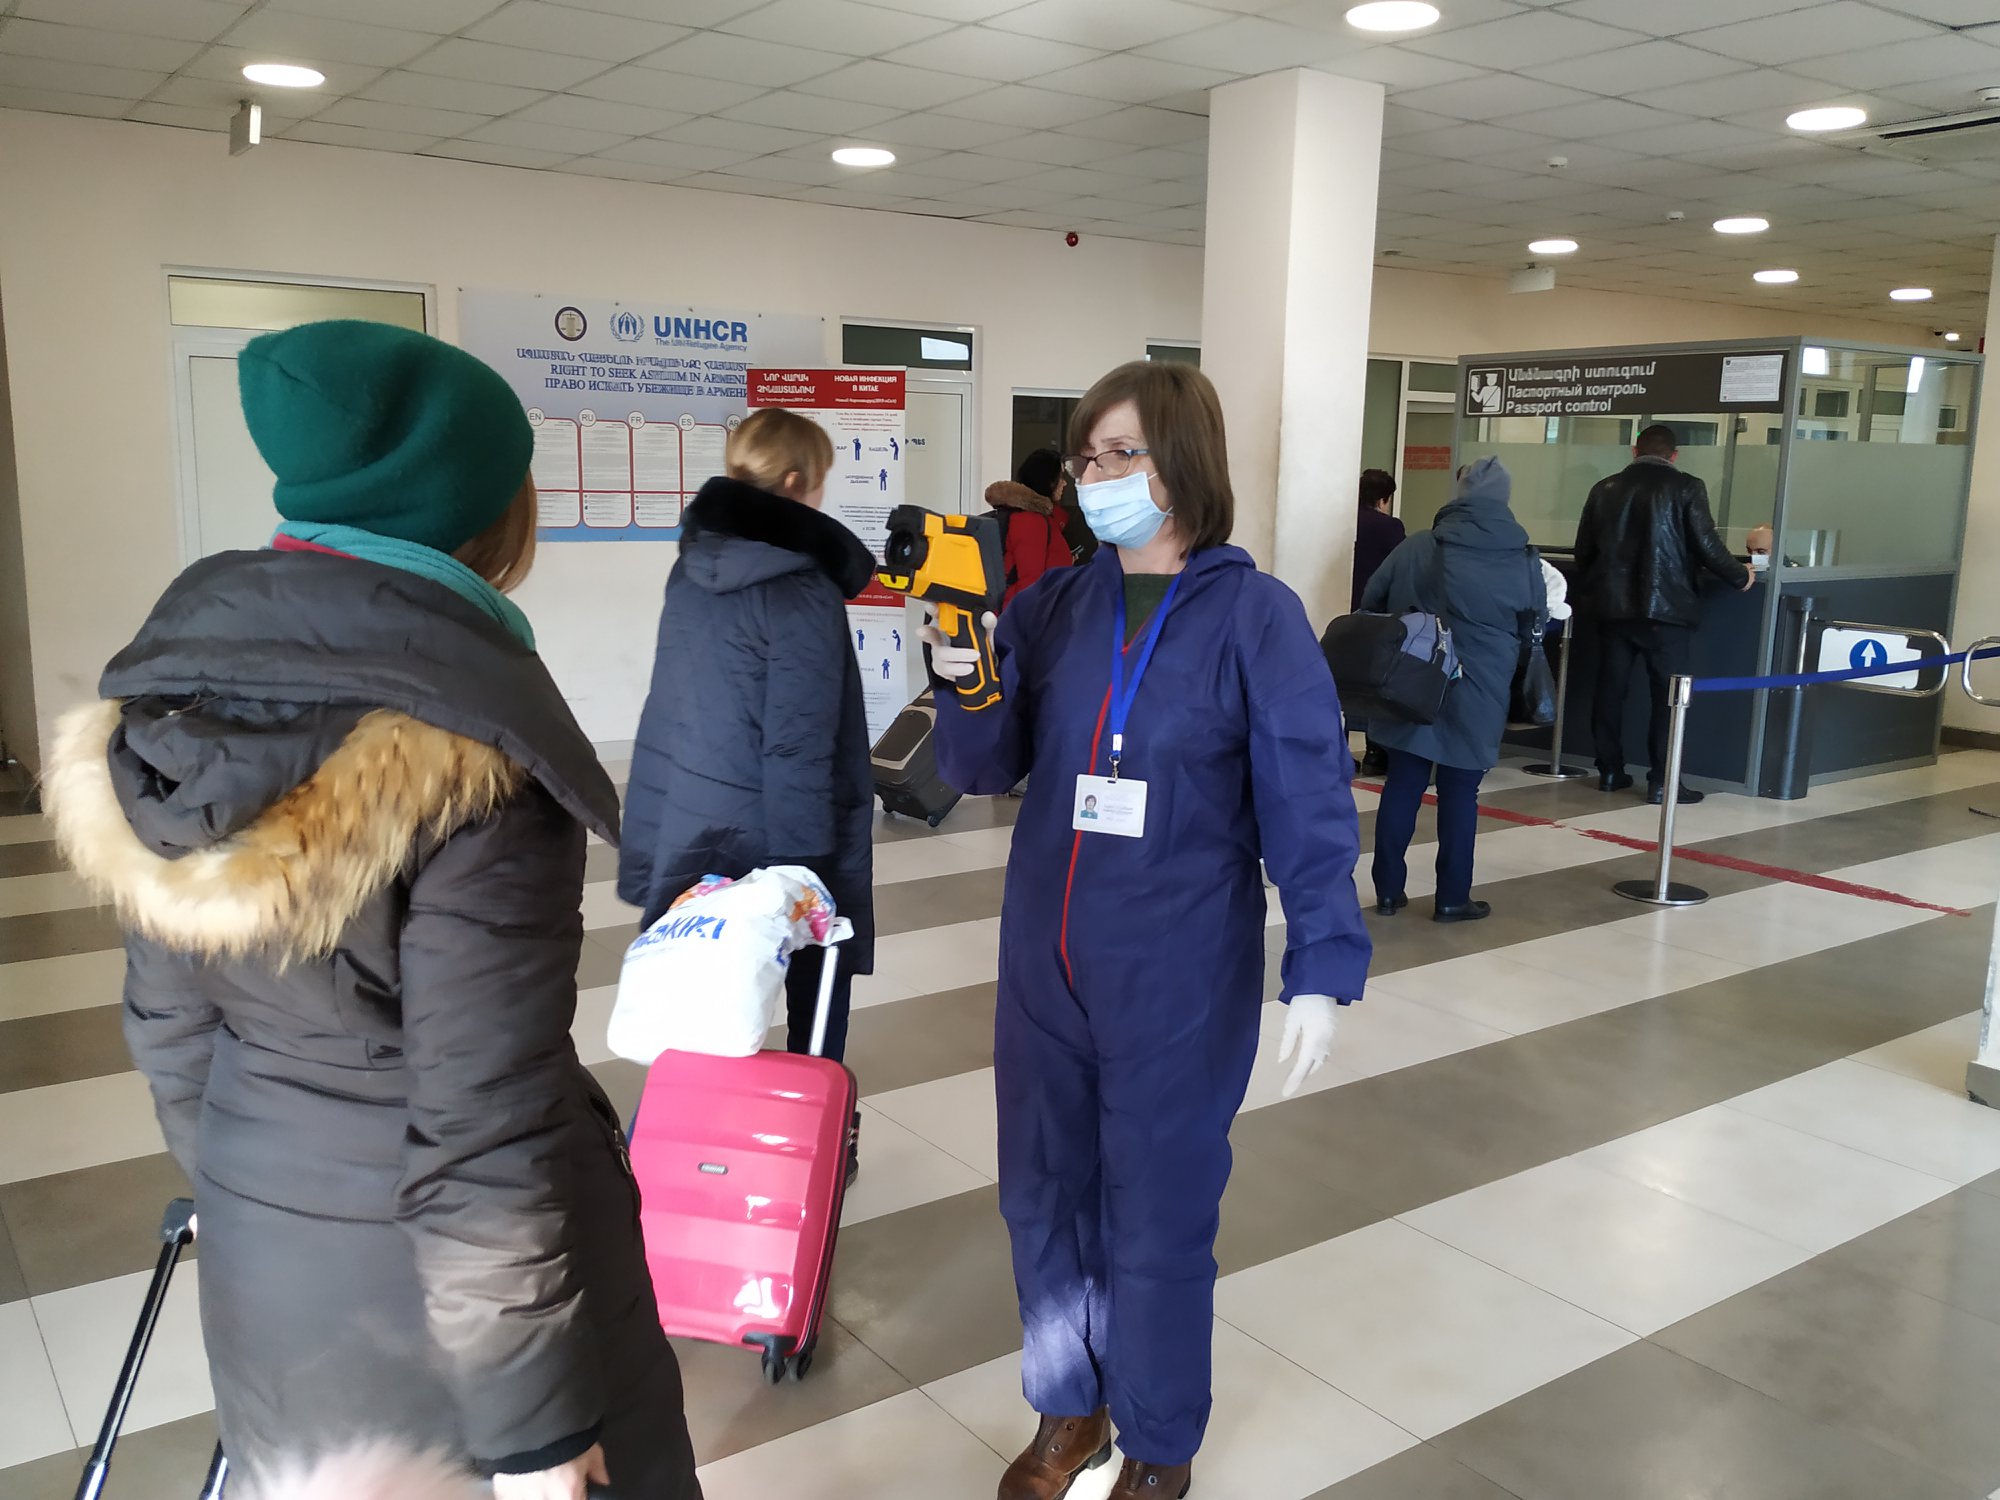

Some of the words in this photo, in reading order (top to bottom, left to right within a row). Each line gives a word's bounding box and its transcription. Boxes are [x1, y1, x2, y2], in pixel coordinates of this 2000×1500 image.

[654, 316, 747, 342] UNHCR
[655, 338, 670, 346] The
[720, 342, 747, 352] Agency
[550, 364, 587, 376] RIGHT
[590, 366, 606, 377] TO
[608, 367, 637, 379] SEEK
[640, 369, 687, 381] ASYLUM
[689, 372, 701, 383] IN
[704, 373, 748, 385] ARMENI
[545, 378, 586, 390] ПРАВО
[588, 380, 634, 392] ИСКАТЬ
[696, 386, 704, 396] В
[1507, 384, 1583, 399] Паспортный
[1586, 383, 1647, 398] контроль
[1505, 400, 1562, 416] Passport
[1565, 398, 1612, 412] control
[529, 412, 542, 421] EN
[581, 414, 594, 422] RU
[630, 416, 643, 424] FR
[681, 418, 692, 426] ES
[729, 419, 740, 427] AR
